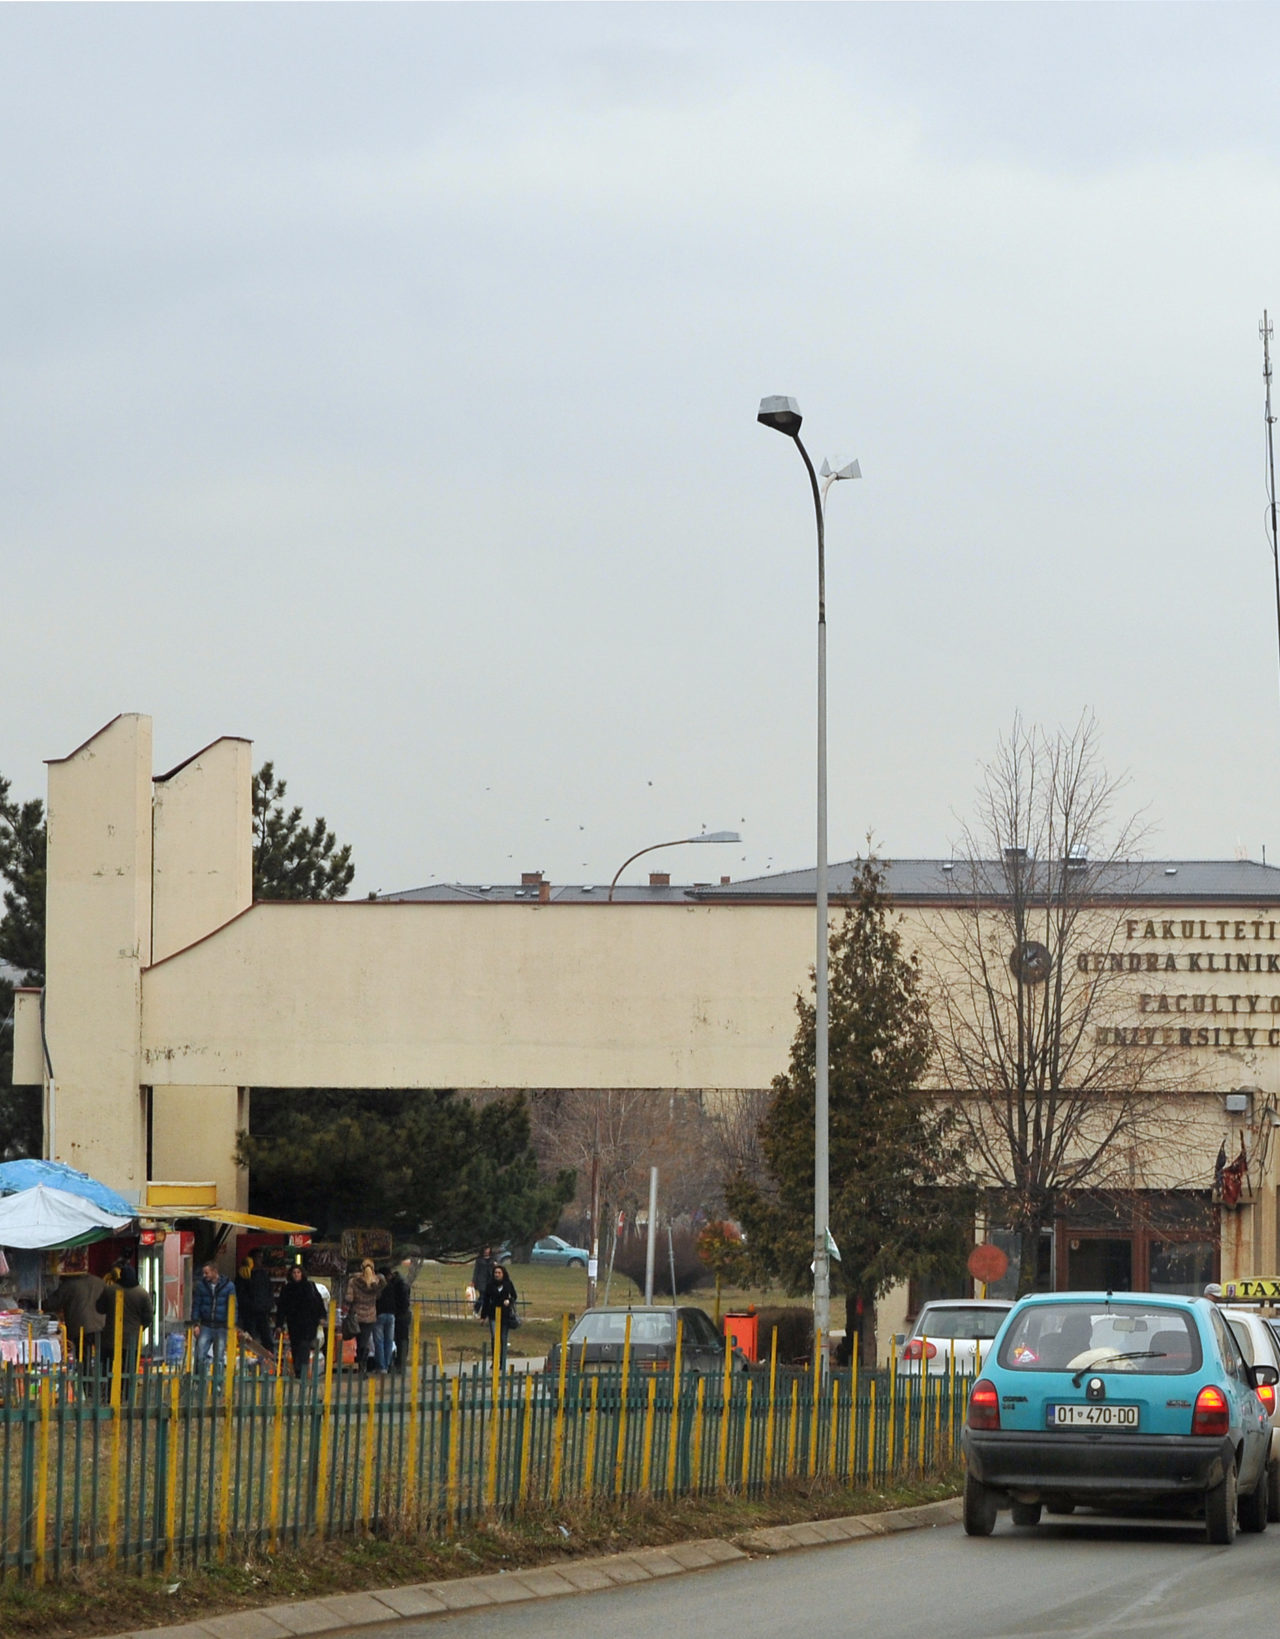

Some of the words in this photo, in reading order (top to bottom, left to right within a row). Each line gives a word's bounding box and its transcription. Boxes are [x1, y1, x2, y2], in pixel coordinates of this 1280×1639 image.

[1126, 920, 1276, 940] FAKULTETI
[1077, 953, 1177, 974] QENDRA
[1139, 994, 1260, 1014] FACULTY
[1096, 1027, 1258, 1048] UNIVERSITY
